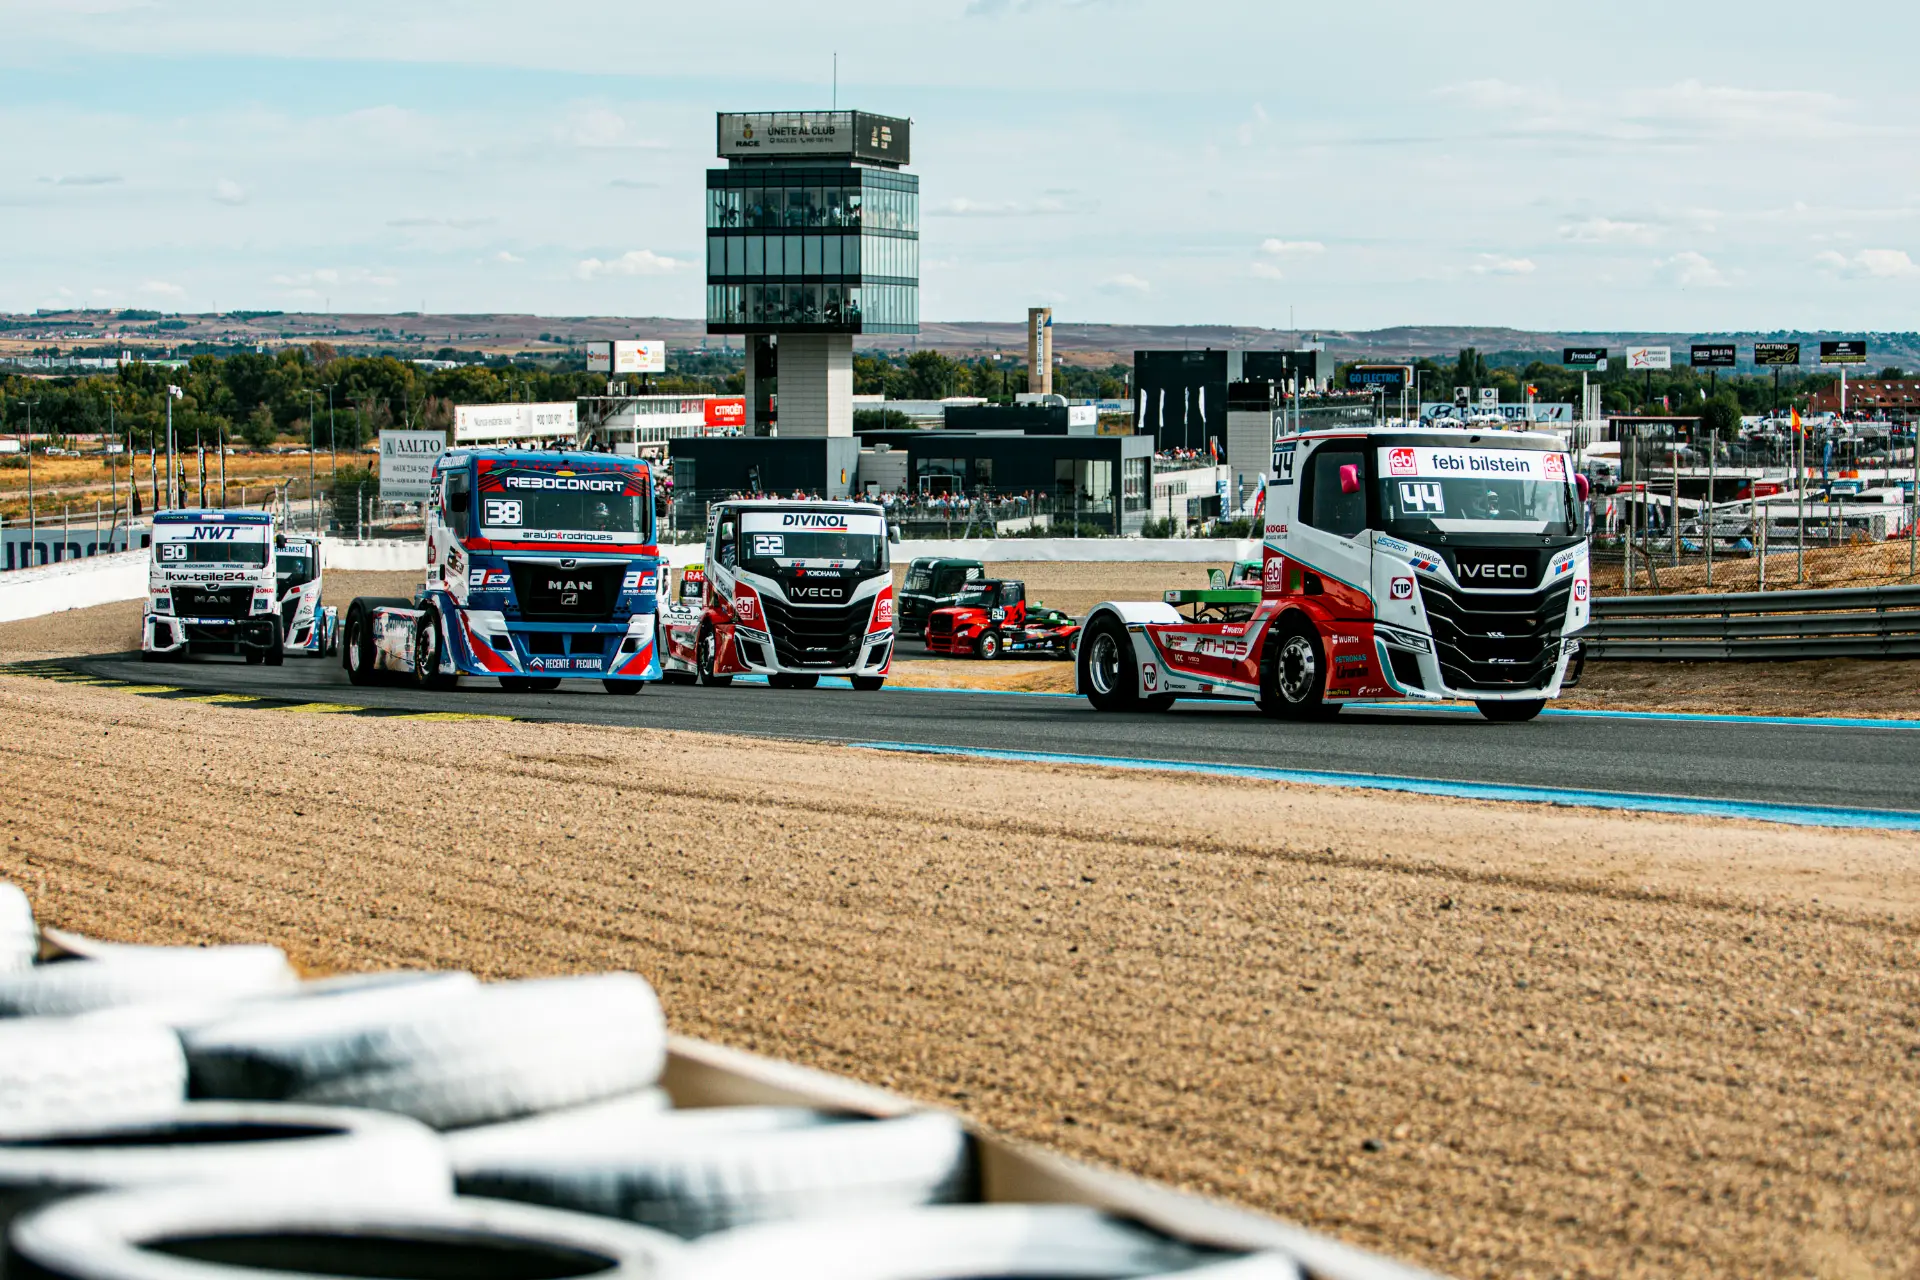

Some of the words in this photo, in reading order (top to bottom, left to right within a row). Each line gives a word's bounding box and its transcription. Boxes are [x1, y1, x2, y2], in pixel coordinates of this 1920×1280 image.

[812, 126, 835, 135] CLUB
[1350, 374, 1362, 383] GO
[1363, 373, 1400, 383] ELECTRIC
[386, 442, 393, 454] A
[398, 440, 440, 453] AALTO
[1273, 452, 1293, 478] 44
[1432, 455, 1464, 470] febi
[1470, 456, 1530, 472] bilstein
[506, 477, 624, 492] REBOCONORT
[1402, 484, 1442, 511] 44
[488, 502, 520, 524] 38
[783, 514, 848, 526] DIVINOL
[193, 527, 240, 539] NWT
[756, 537, 783, 554] 22
[164, 545, 186, 559] 30
[1414, 550, 1442, 565] winkler
[1552, 551, 1574, 566] winkler
[166, 572, 258, 581] lkw-teile24.de
[1457, 564, 1527, 578] IVECO
[548, 581, 592, 590] MAN
[1394, 584, 1410, 594] TIP
[1577, 586, 1586, 595] TIP
[791, 587, 842, 597] IVECO
[993, 611, 1004, 619] 24
[545, 659, 569, 668] RECENTE
[576, 659, 602, 669] PECULIAR
[1335, 654, 1366, 663] PETRONAS
[1145, 672, 1155, 684] TIP
